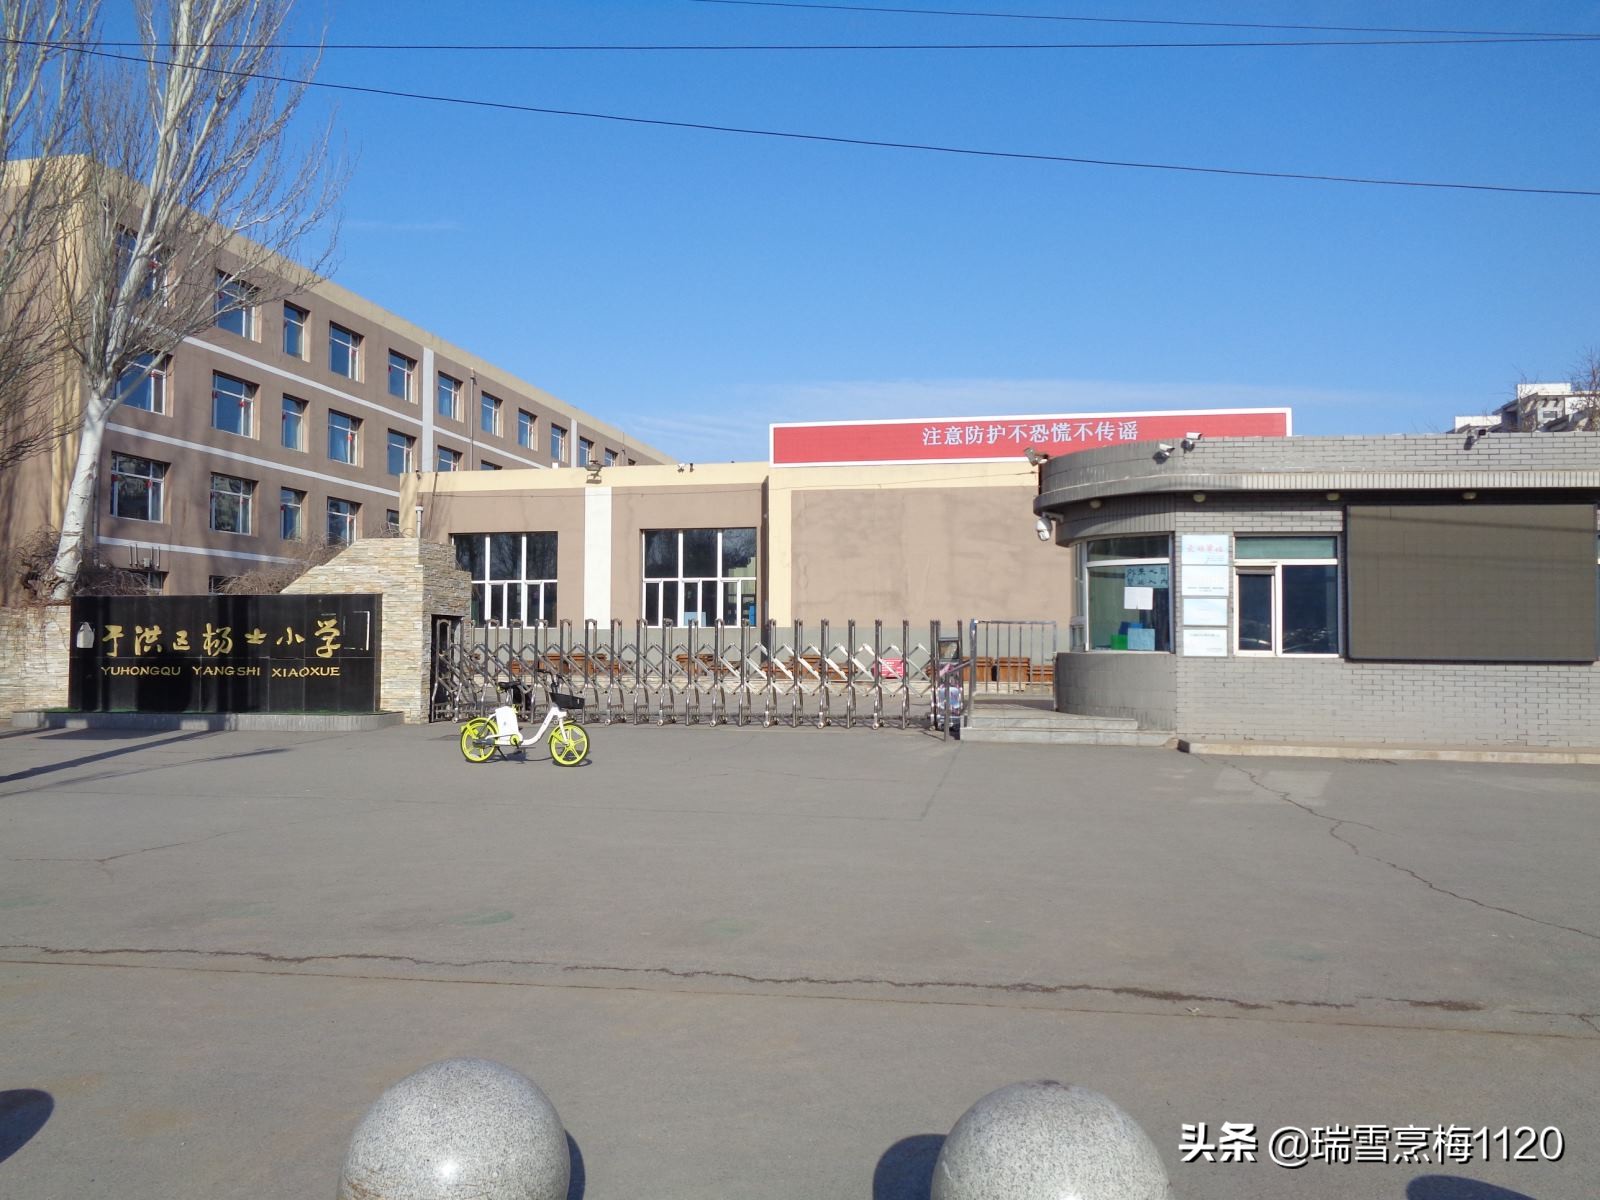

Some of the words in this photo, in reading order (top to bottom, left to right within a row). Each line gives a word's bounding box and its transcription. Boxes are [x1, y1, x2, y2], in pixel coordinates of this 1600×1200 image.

[922, 420, 1139, 446] 注意防护不恐慌不传谣
[102, 619, 341, 658] 于洪区杨士小学
[101, 666, 181, 676] YUHONGQU
[192, 666, 261, 677] YANGSHI
[271, 666, 341, 678] XIAOXUE
